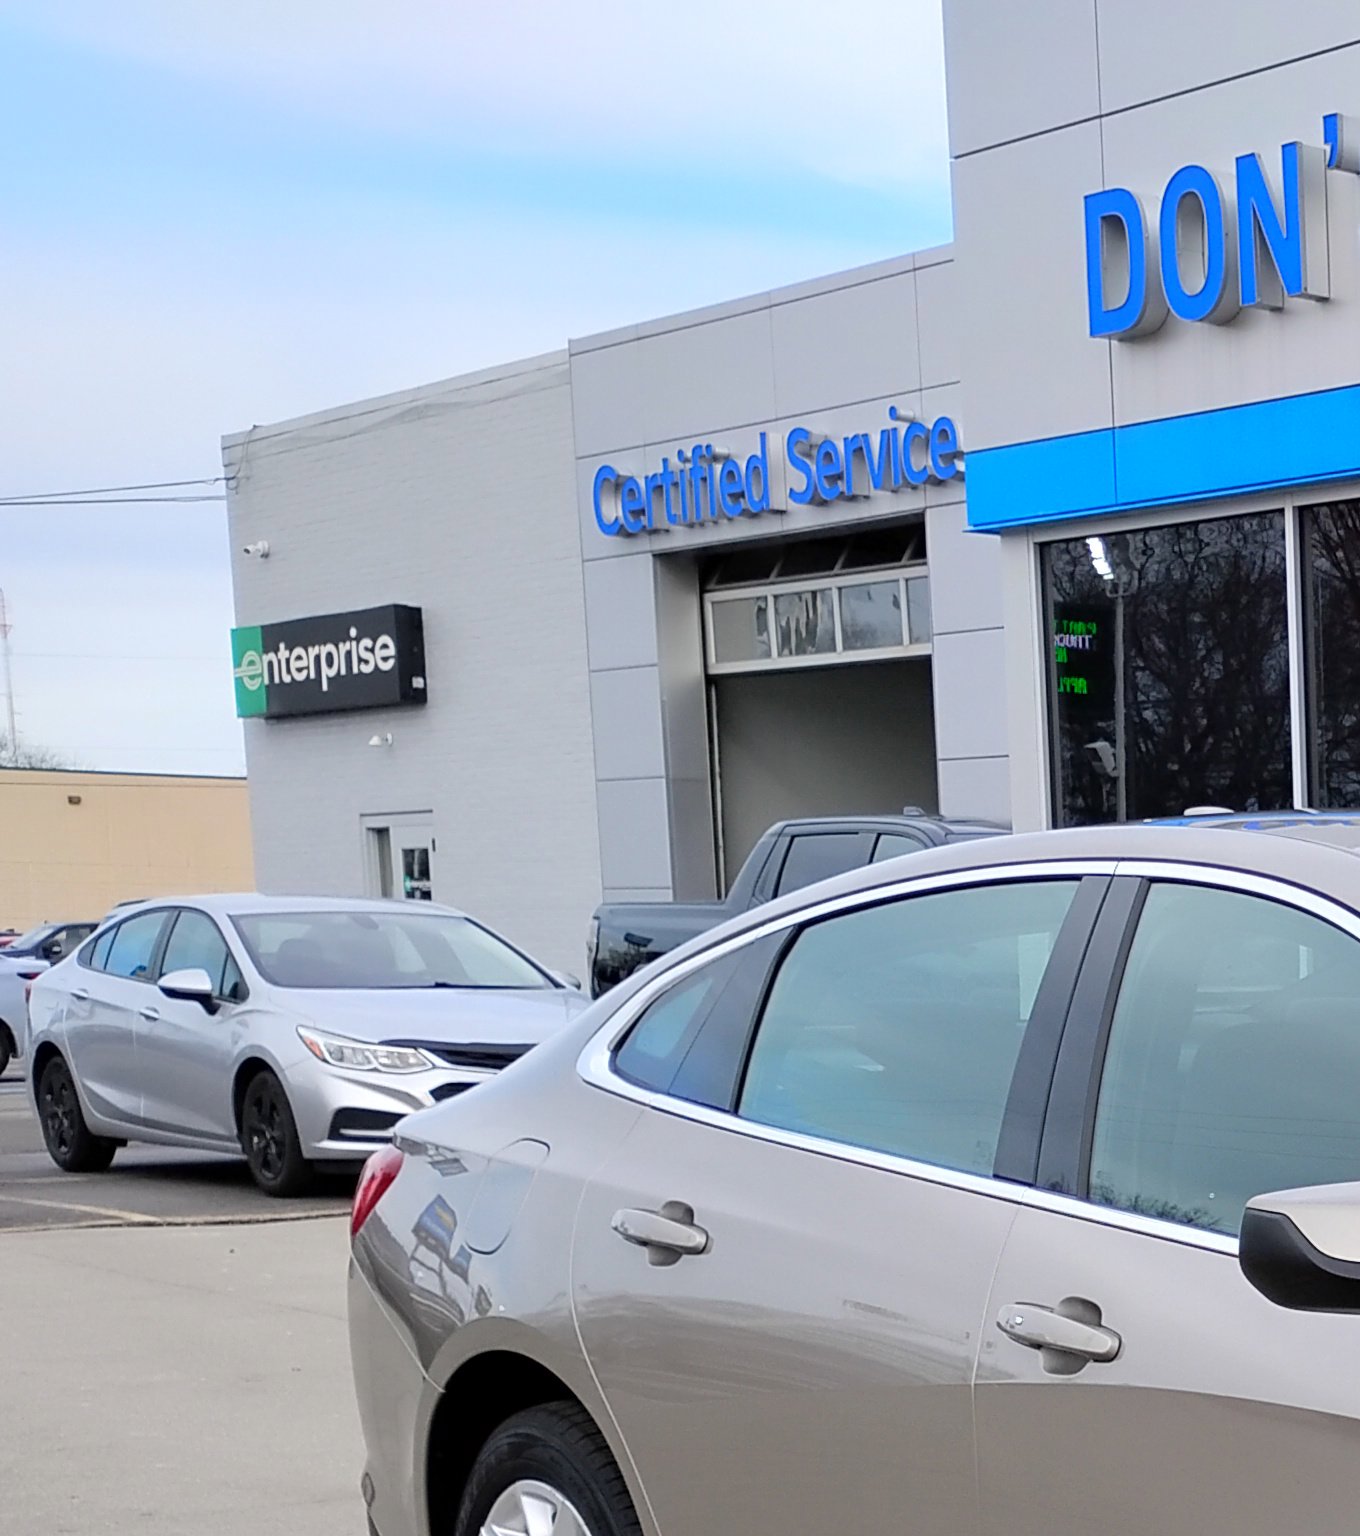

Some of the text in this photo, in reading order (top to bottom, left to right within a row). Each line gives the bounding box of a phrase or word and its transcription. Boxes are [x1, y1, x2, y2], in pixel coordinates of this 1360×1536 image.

[592, 405, 960, 537] Certified Service
[234, 626, 397, 692] enterprise
